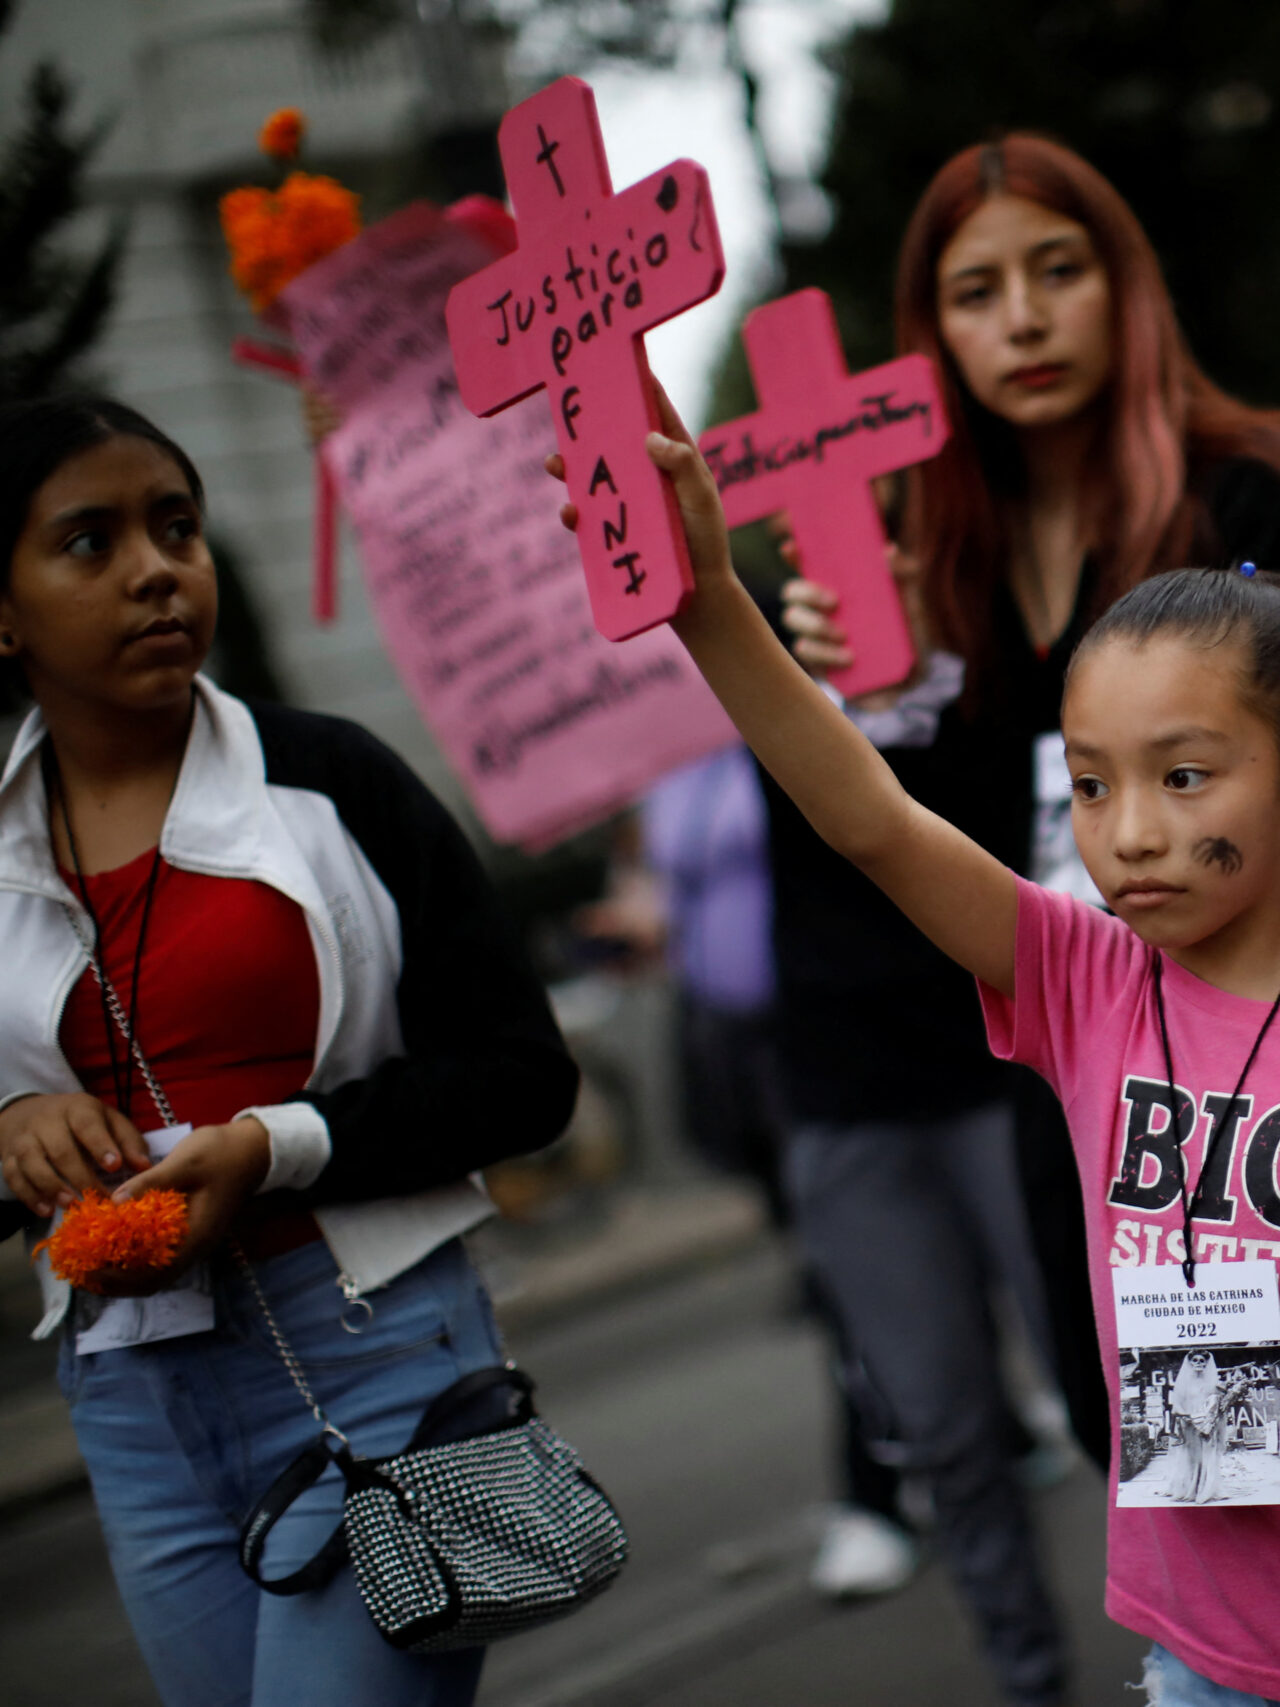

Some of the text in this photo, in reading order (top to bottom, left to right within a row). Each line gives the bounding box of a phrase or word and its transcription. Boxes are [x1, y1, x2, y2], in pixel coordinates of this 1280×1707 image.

[552, 279, 642, 377] para
[1121, 1288, 1264, 1306] MARCHA DE LAS CATRINAS
[1144, 1303, 1246, 1318] CIUDAD DE MÉXICO
[1176, 1322, 1217, 1338] 2022
